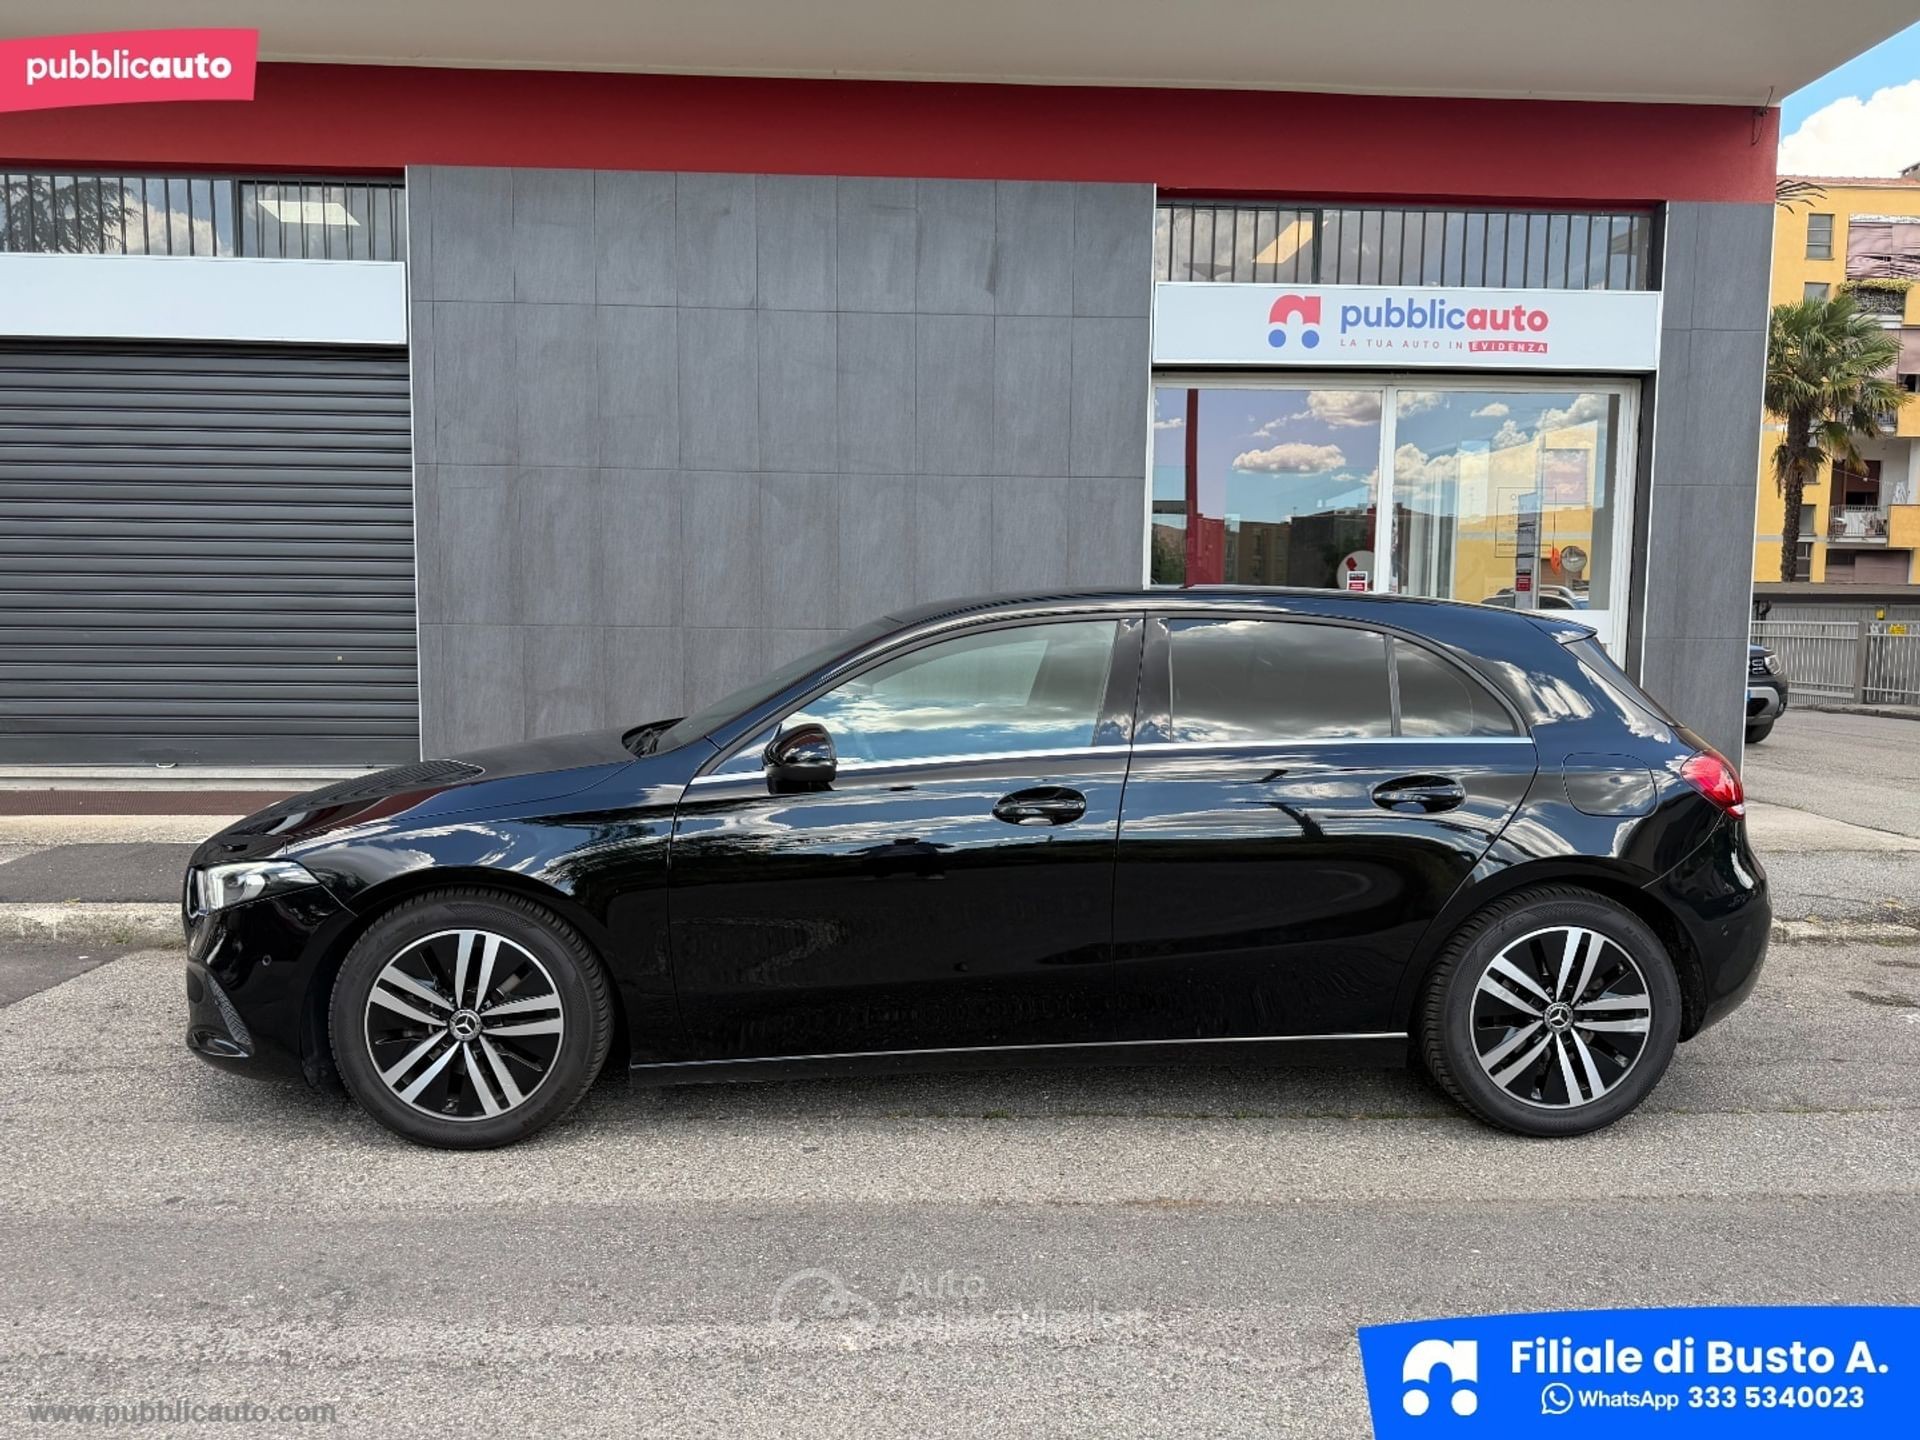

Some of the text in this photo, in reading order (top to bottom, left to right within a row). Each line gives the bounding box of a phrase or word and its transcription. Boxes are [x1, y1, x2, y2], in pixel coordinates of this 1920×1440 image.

[1340, 297, 1549, 335] pubblicauto
[1339, 339, 1546, 353] LA TUA AUTO IN EVIDENZA
